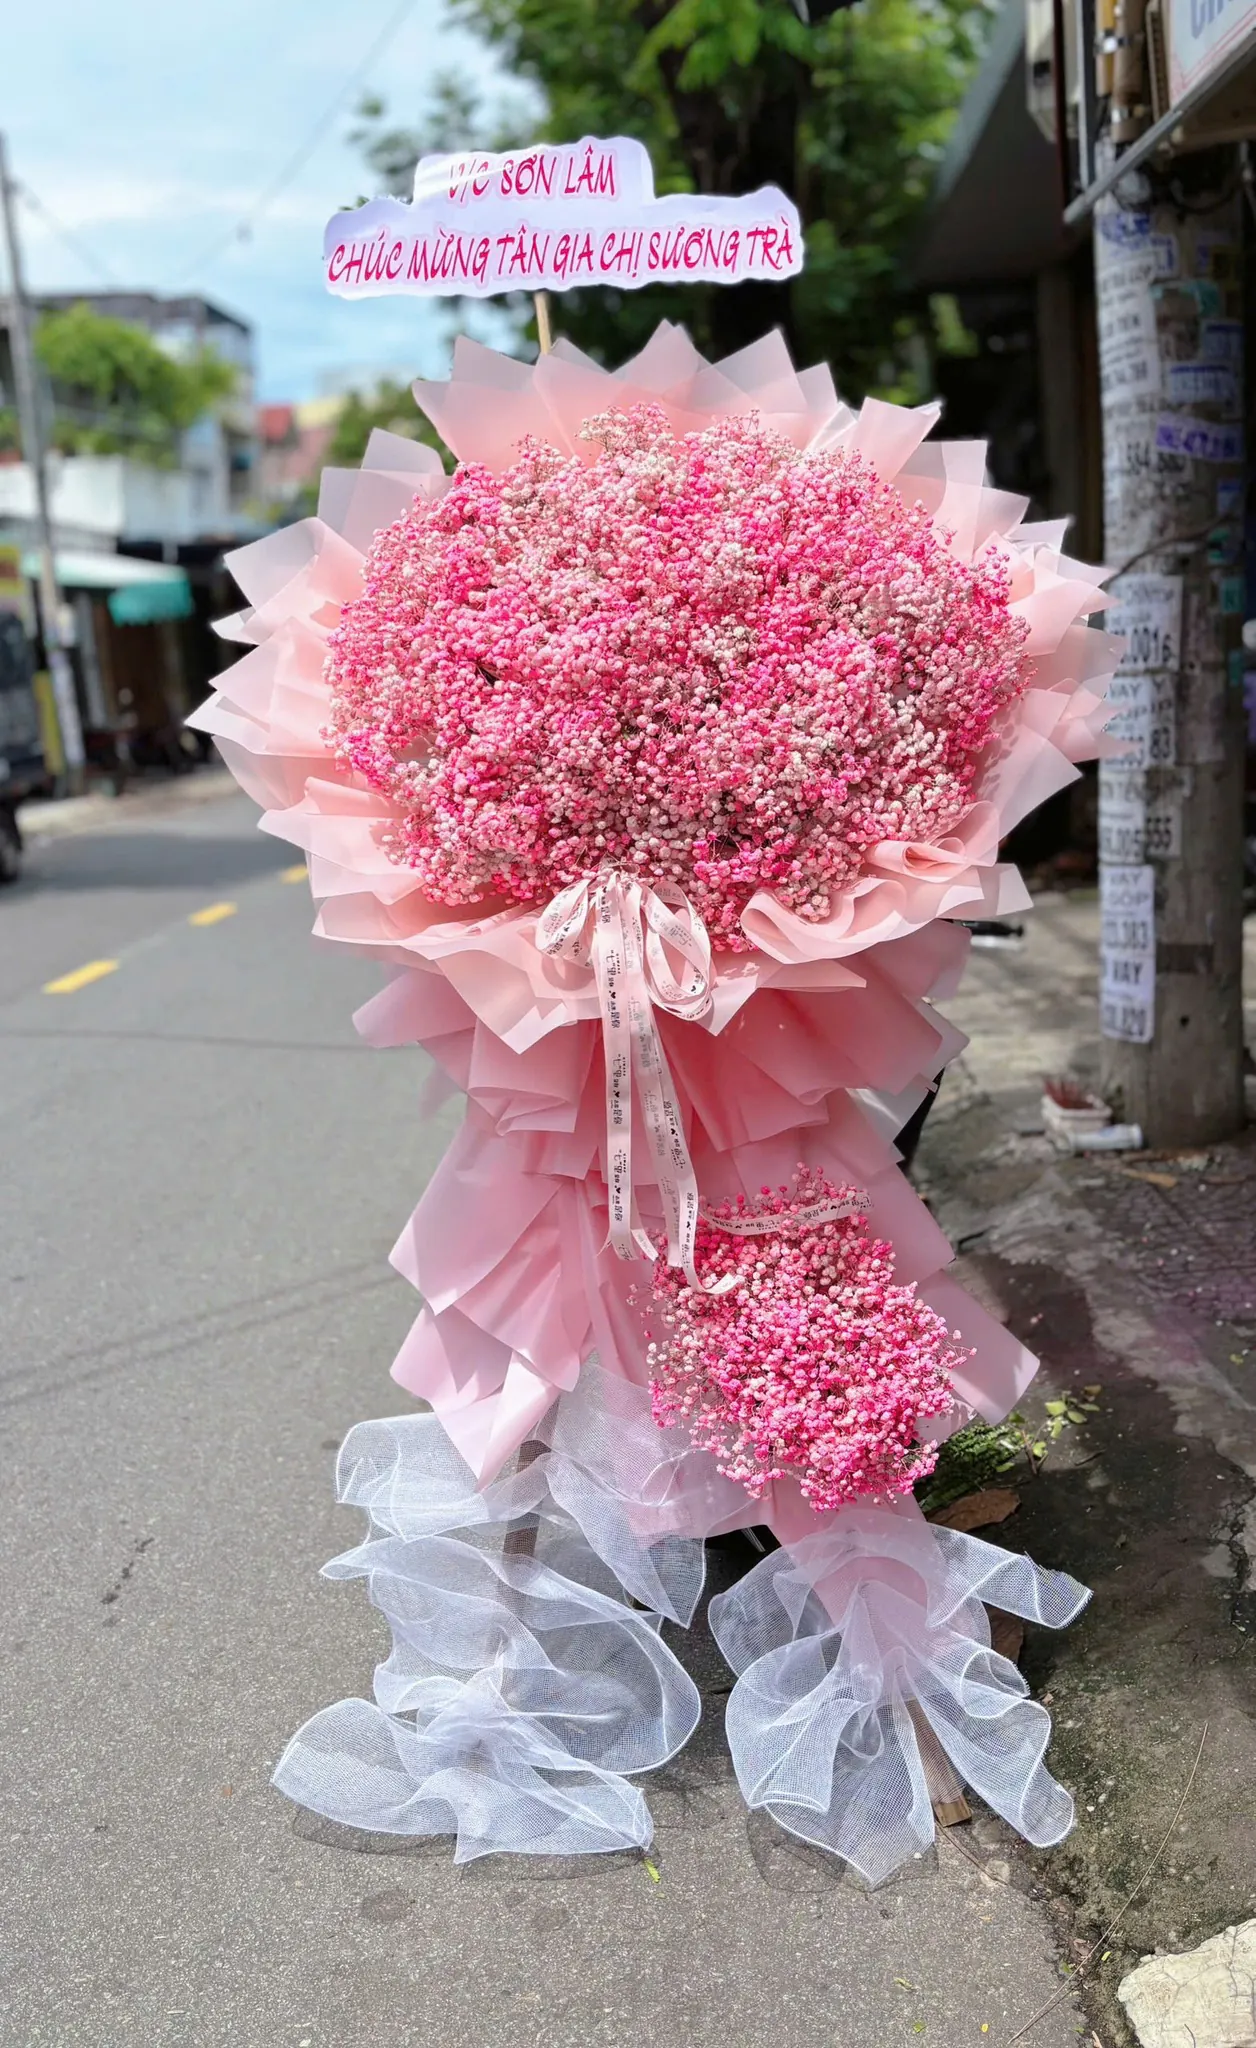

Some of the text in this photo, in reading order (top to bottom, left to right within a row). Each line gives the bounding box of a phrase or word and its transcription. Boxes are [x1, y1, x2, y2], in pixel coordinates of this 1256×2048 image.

[500, 154, 557, 196] SƠN
[564, 144, 616, 196] LÂM
[328, 216, 793, 284] CHÚC MỪNG TÂN GIA CHỊ SƯƠNG TRÀ
